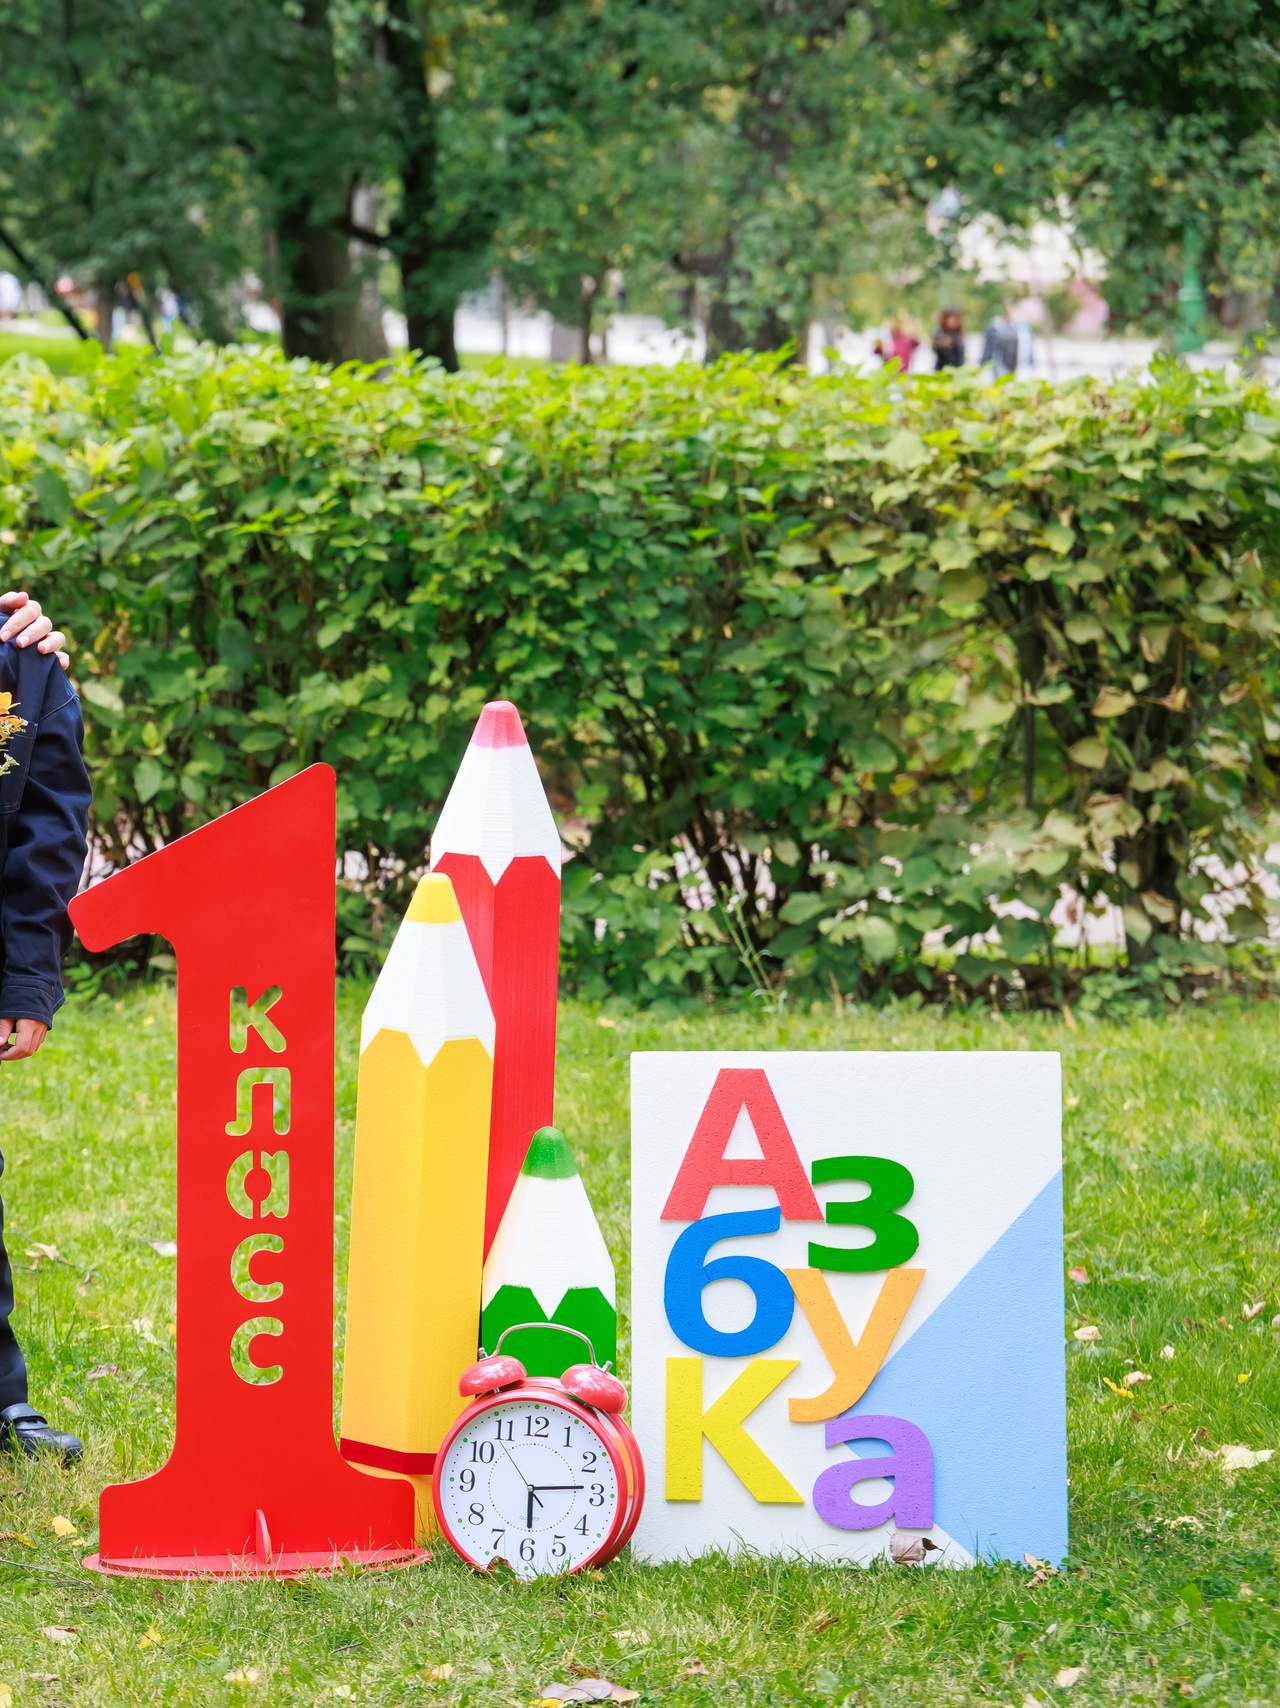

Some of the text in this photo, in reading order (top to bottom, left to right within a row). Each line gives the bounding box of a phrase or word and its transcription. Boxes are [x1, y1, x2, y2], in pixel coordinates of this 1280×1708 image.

[68, 762, 415, 1572] 1
[494, 1418, 515, 1441] 11
[524, 1415, 550, 1438] 12
[562, 1425, 573, 1447] 1
[469, 1440, 495, 1464] 10
[581, 1451, 597, 1473] 2
[459, 1468, 476, 1492] 9
[589, 1483, 605, 1507] 3
[468, 1502, 485, 1525] 8
[574, 1513, 590, 1536] 4
[491, 1528, 506, 1550] 7
[519, 1537, 536, 1562] 6
[551, 1534, 567, 1557] 5
